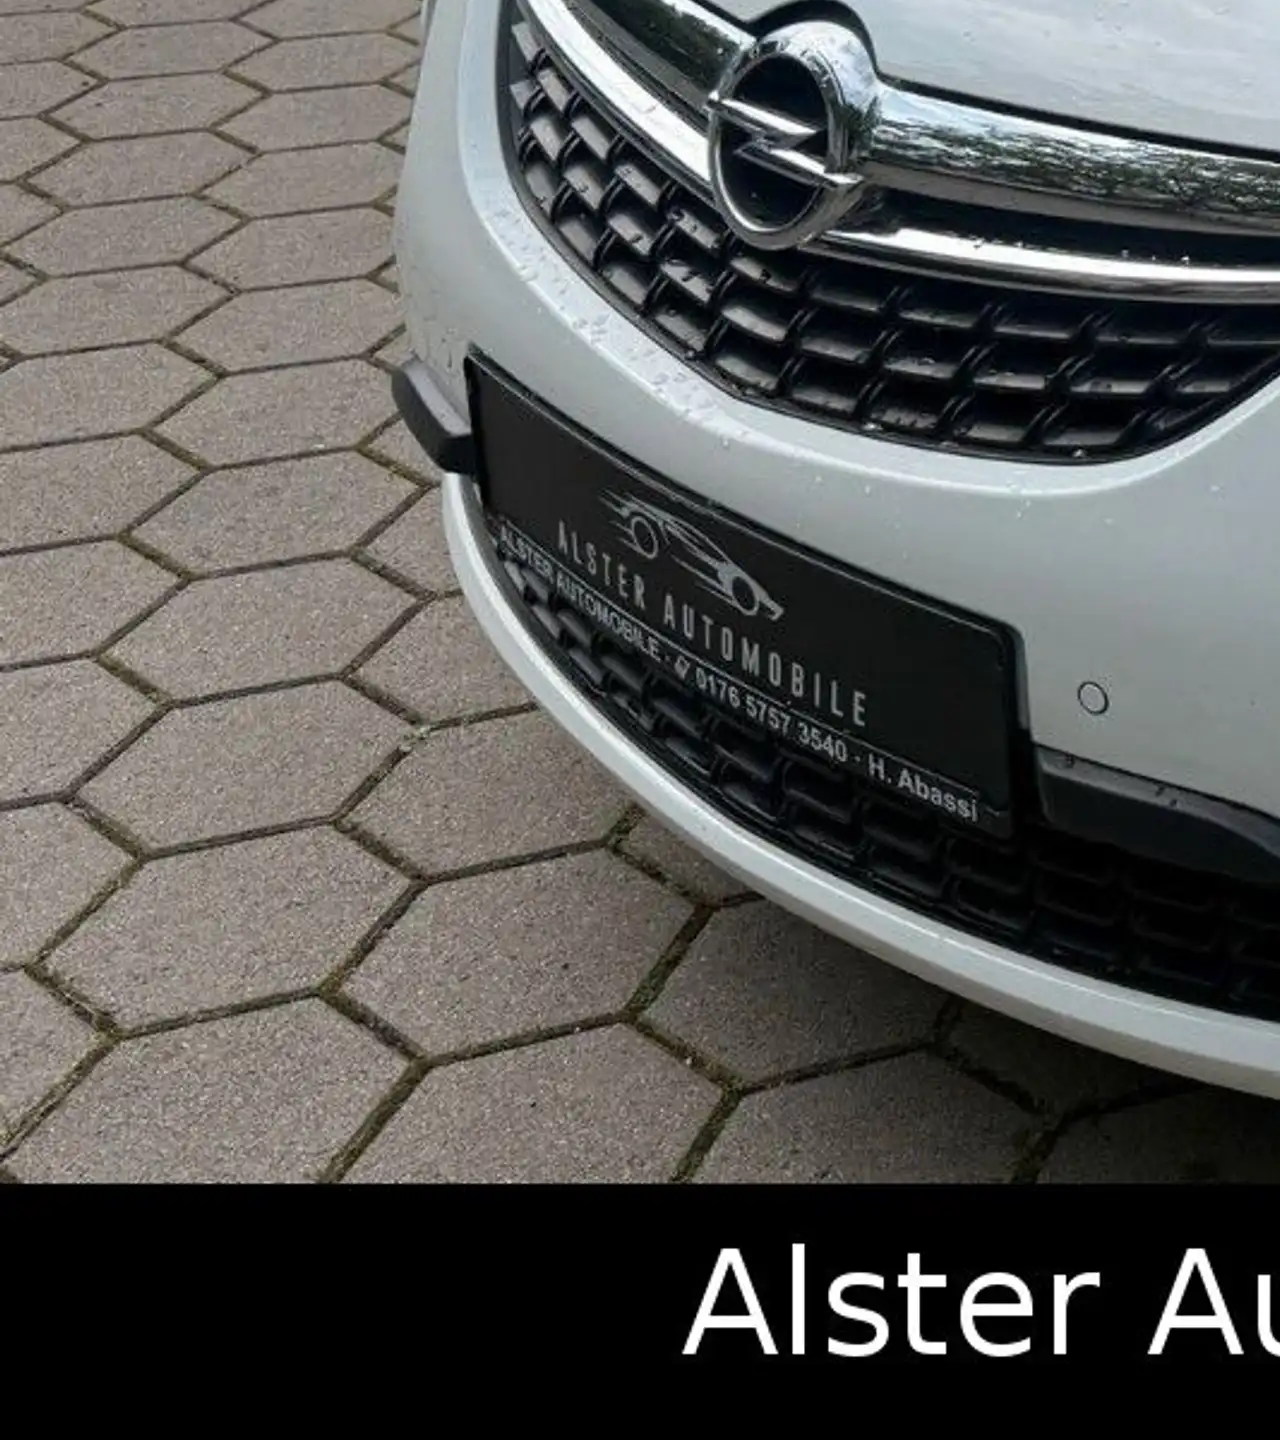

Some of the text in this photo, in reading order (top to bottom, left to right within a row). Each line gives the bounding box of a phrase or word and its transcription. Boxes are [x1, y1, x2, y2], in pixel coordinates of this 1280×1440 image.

[500, 524, 554, 585] ALSTER
[556, 570, 662, 663] AUTOMOBILE
[694, 666, 741, 708] 0176
[745, 694, 791, 736] 5757
[797, 721, 848, 762] 3540
[868, 752, 893, 784] H.
[897, 768, 978, 822] Abassi
[558, 519, 866, 727] ALSTER AUTOMOBILE
